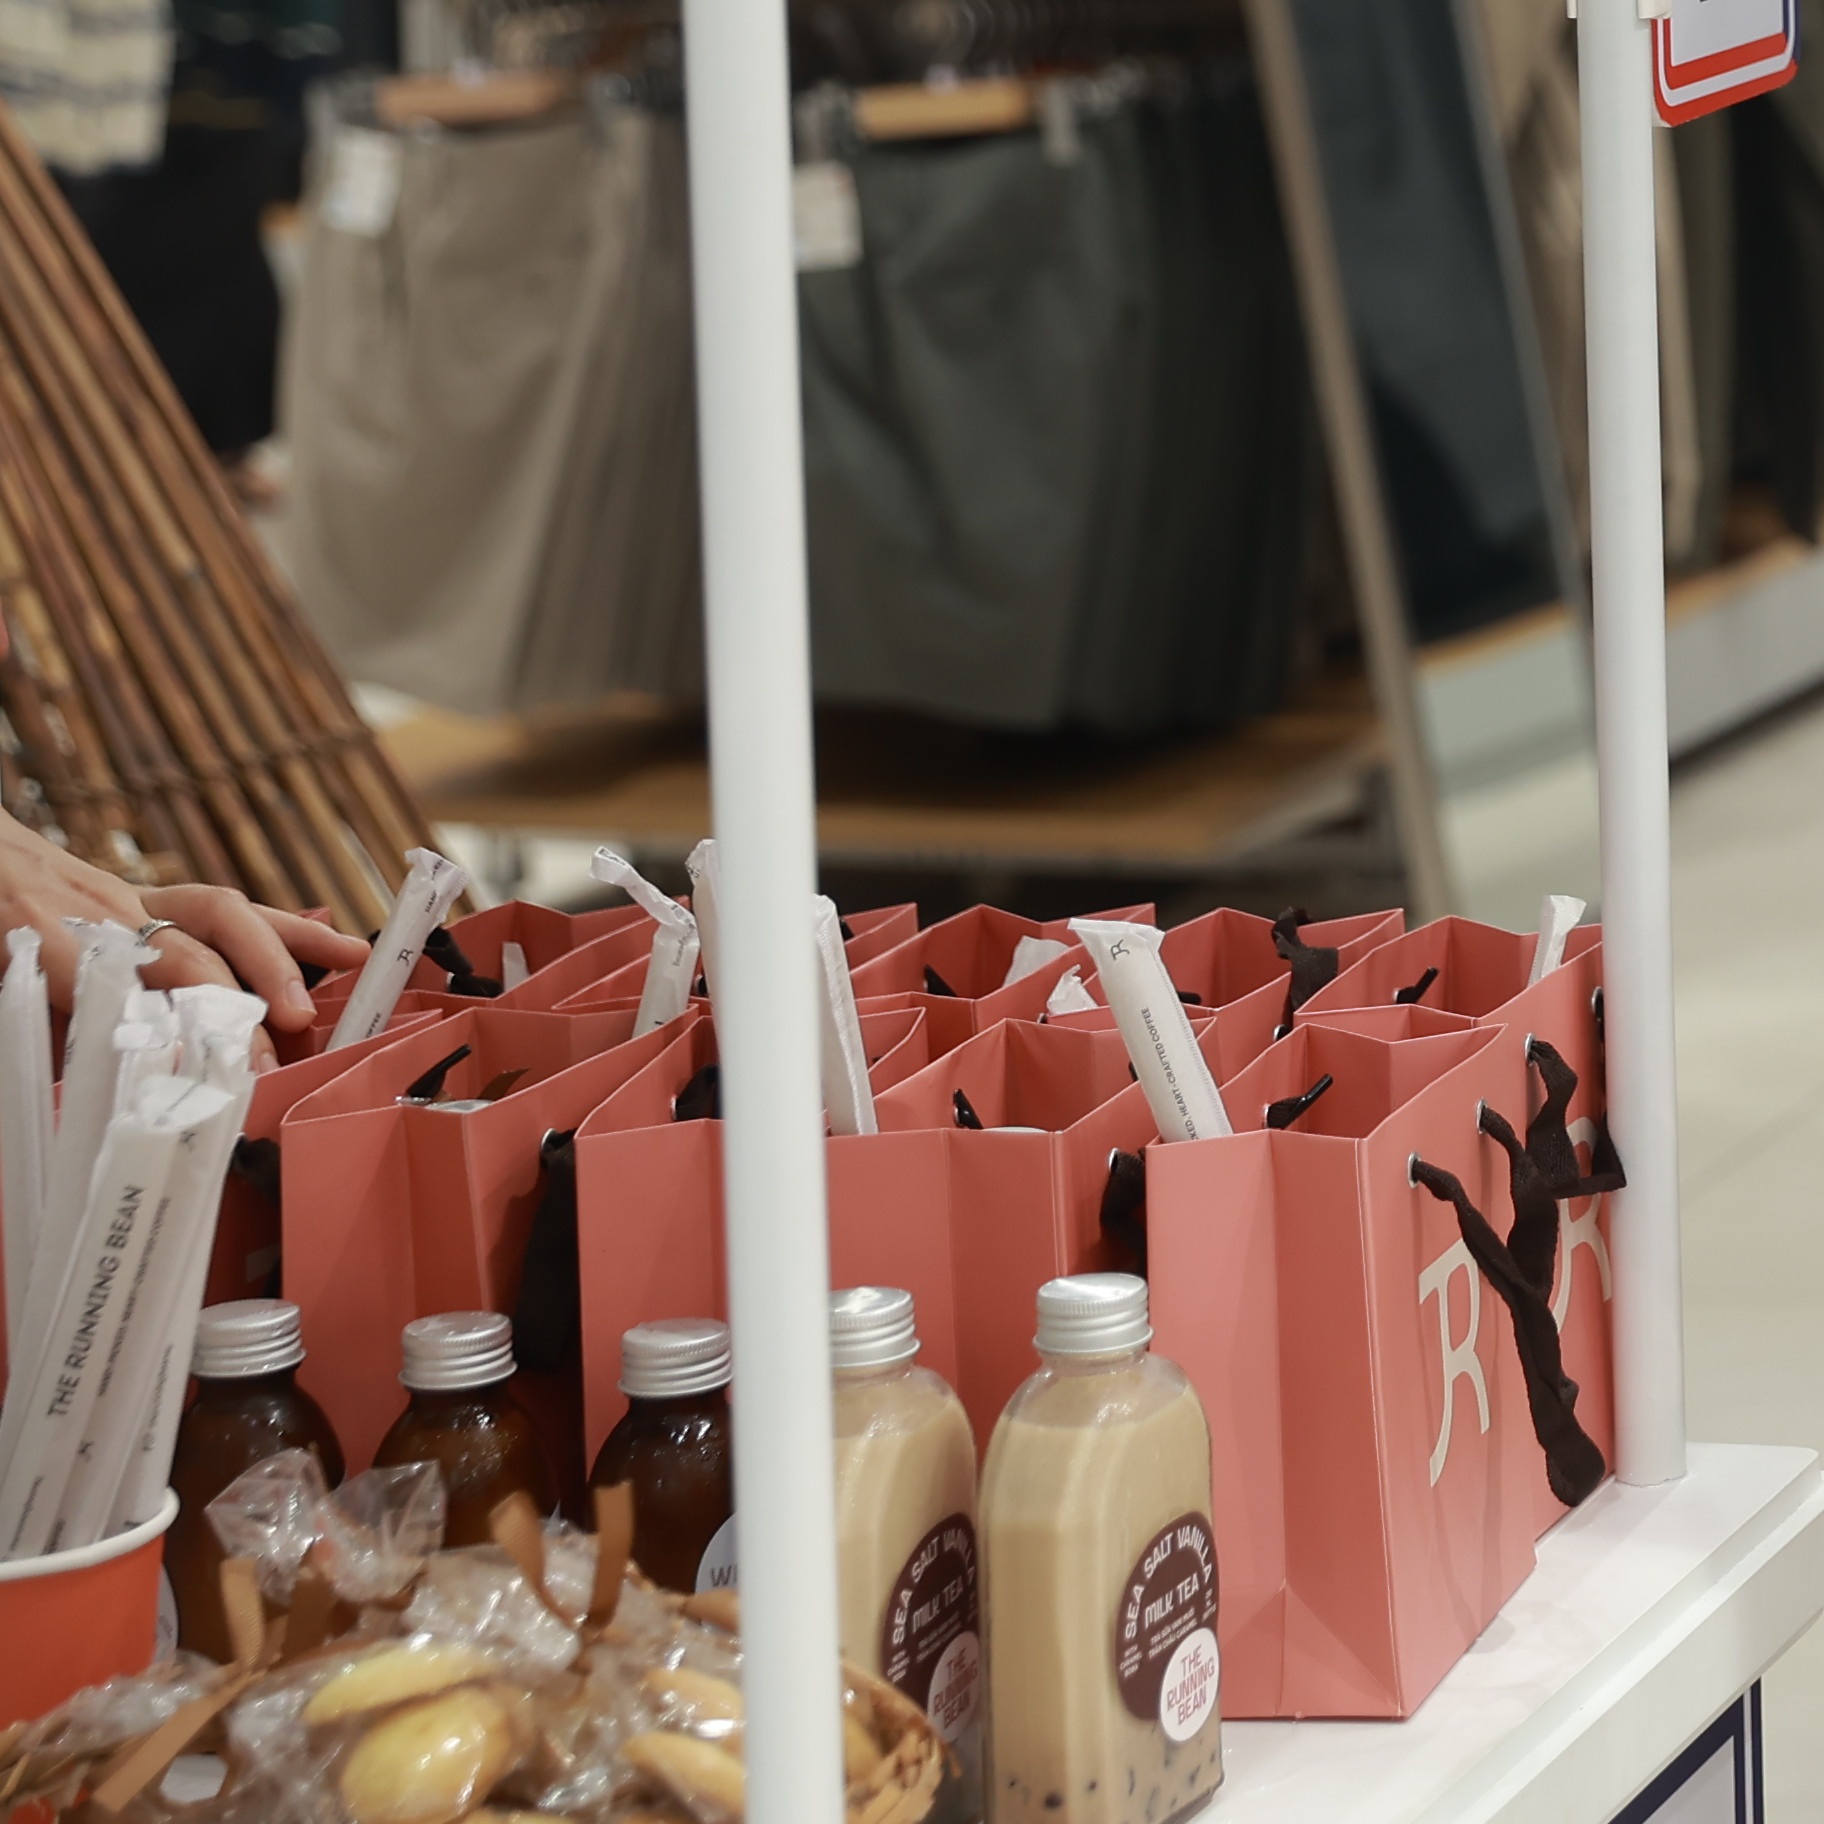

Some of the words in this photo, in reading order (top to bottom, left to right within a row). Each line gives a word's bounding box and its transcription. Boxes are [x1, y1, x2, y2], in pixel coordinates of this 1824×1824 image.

[1141, 1007, 1160, 1043] COFFEE
[47, 1373, 81, 1417] THE
[67, 1256, 121, 1372] RUNNING
[105, 1184, 145, 1249] BEAN
[1125, 1584, 1145, 1639] SEA
[1144, 1532, 1174, 1580] SALT
[1177, 1524, 1213, 1584] VANILLA
[1144, 1590, 1175, 1629] MILK
[1176, 1572, 1200, 1604] TEA
[1166, 1657, 1215, 1712] RUNNING
[1181, 1644, 1203, 1678] THE
[1177, 1684, 1208, 1726] BEAN
